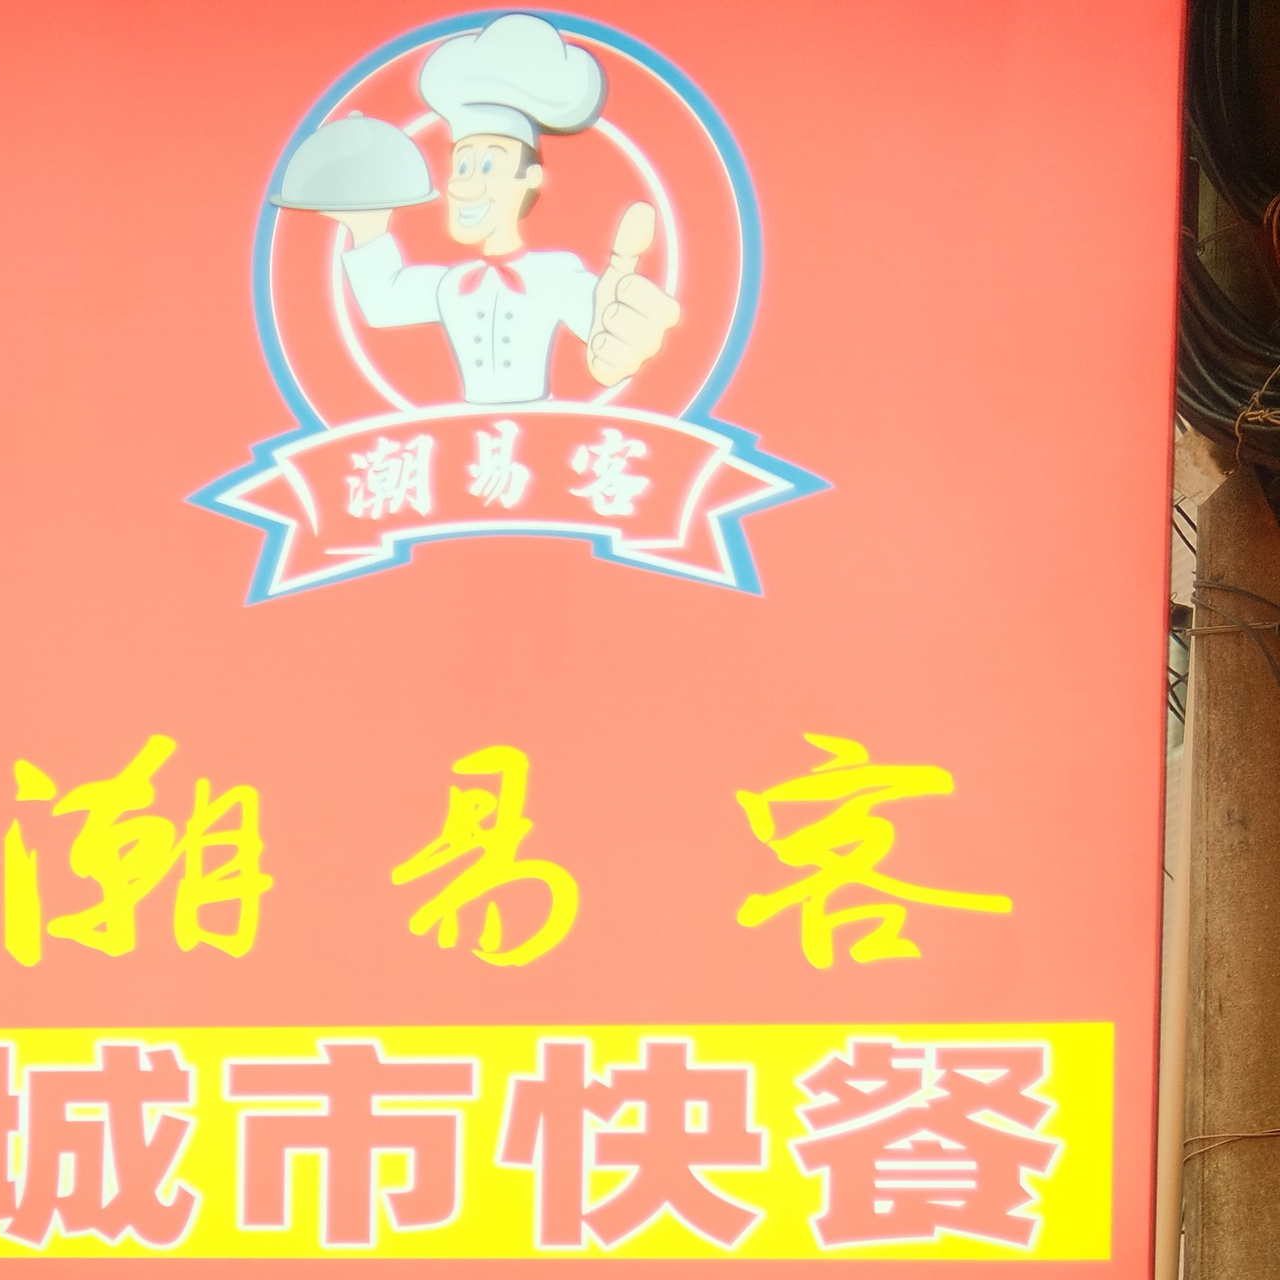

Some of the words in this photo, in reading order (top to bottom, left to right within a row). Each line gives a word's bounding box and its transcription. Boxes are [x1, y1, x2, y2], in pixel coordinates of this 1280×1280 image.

[346, 420, 652, 521] 潮易客
[1, 734, 1014, 969] 潮易客
